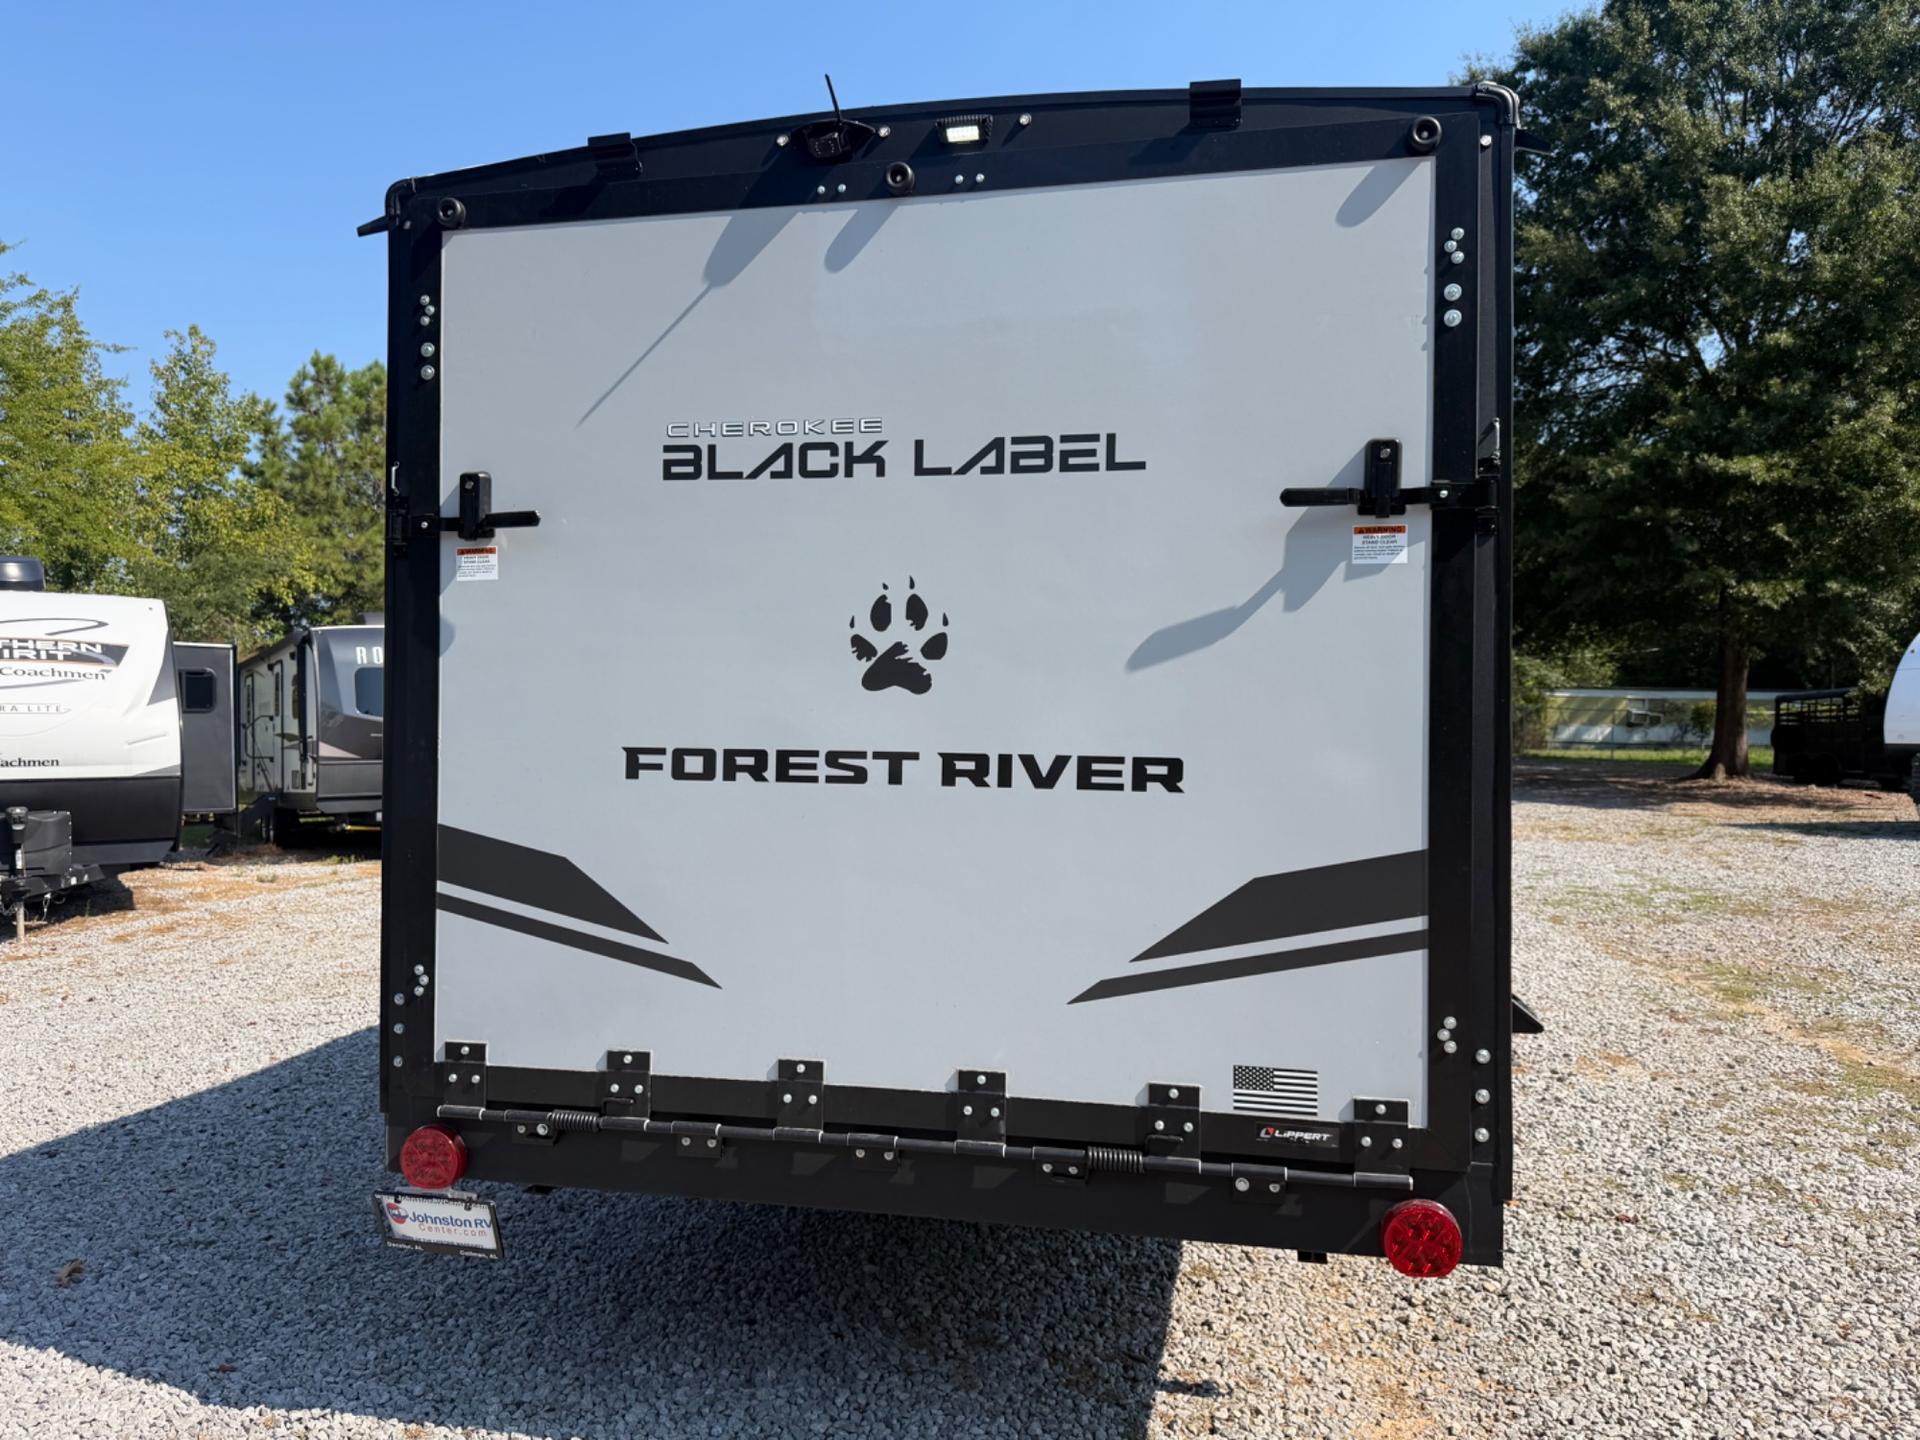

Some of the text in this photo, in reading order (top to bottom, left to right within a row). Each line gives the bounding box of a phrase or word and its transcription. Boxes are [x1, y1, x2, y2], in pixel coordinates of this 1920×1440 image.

[666, 417, 883, 438] CHEROKEE
[662, 433, 1147, 481] BLACK LABEL
[3, 649, 72, 661] IRIT
[0, 666, 106, 680] Coachmen
[621, 746, 1185, 794] FOREST RIVER
[408, 1211, 493, 1229] Johnston RV
[418, 1223, 488, 1237] Center.com
